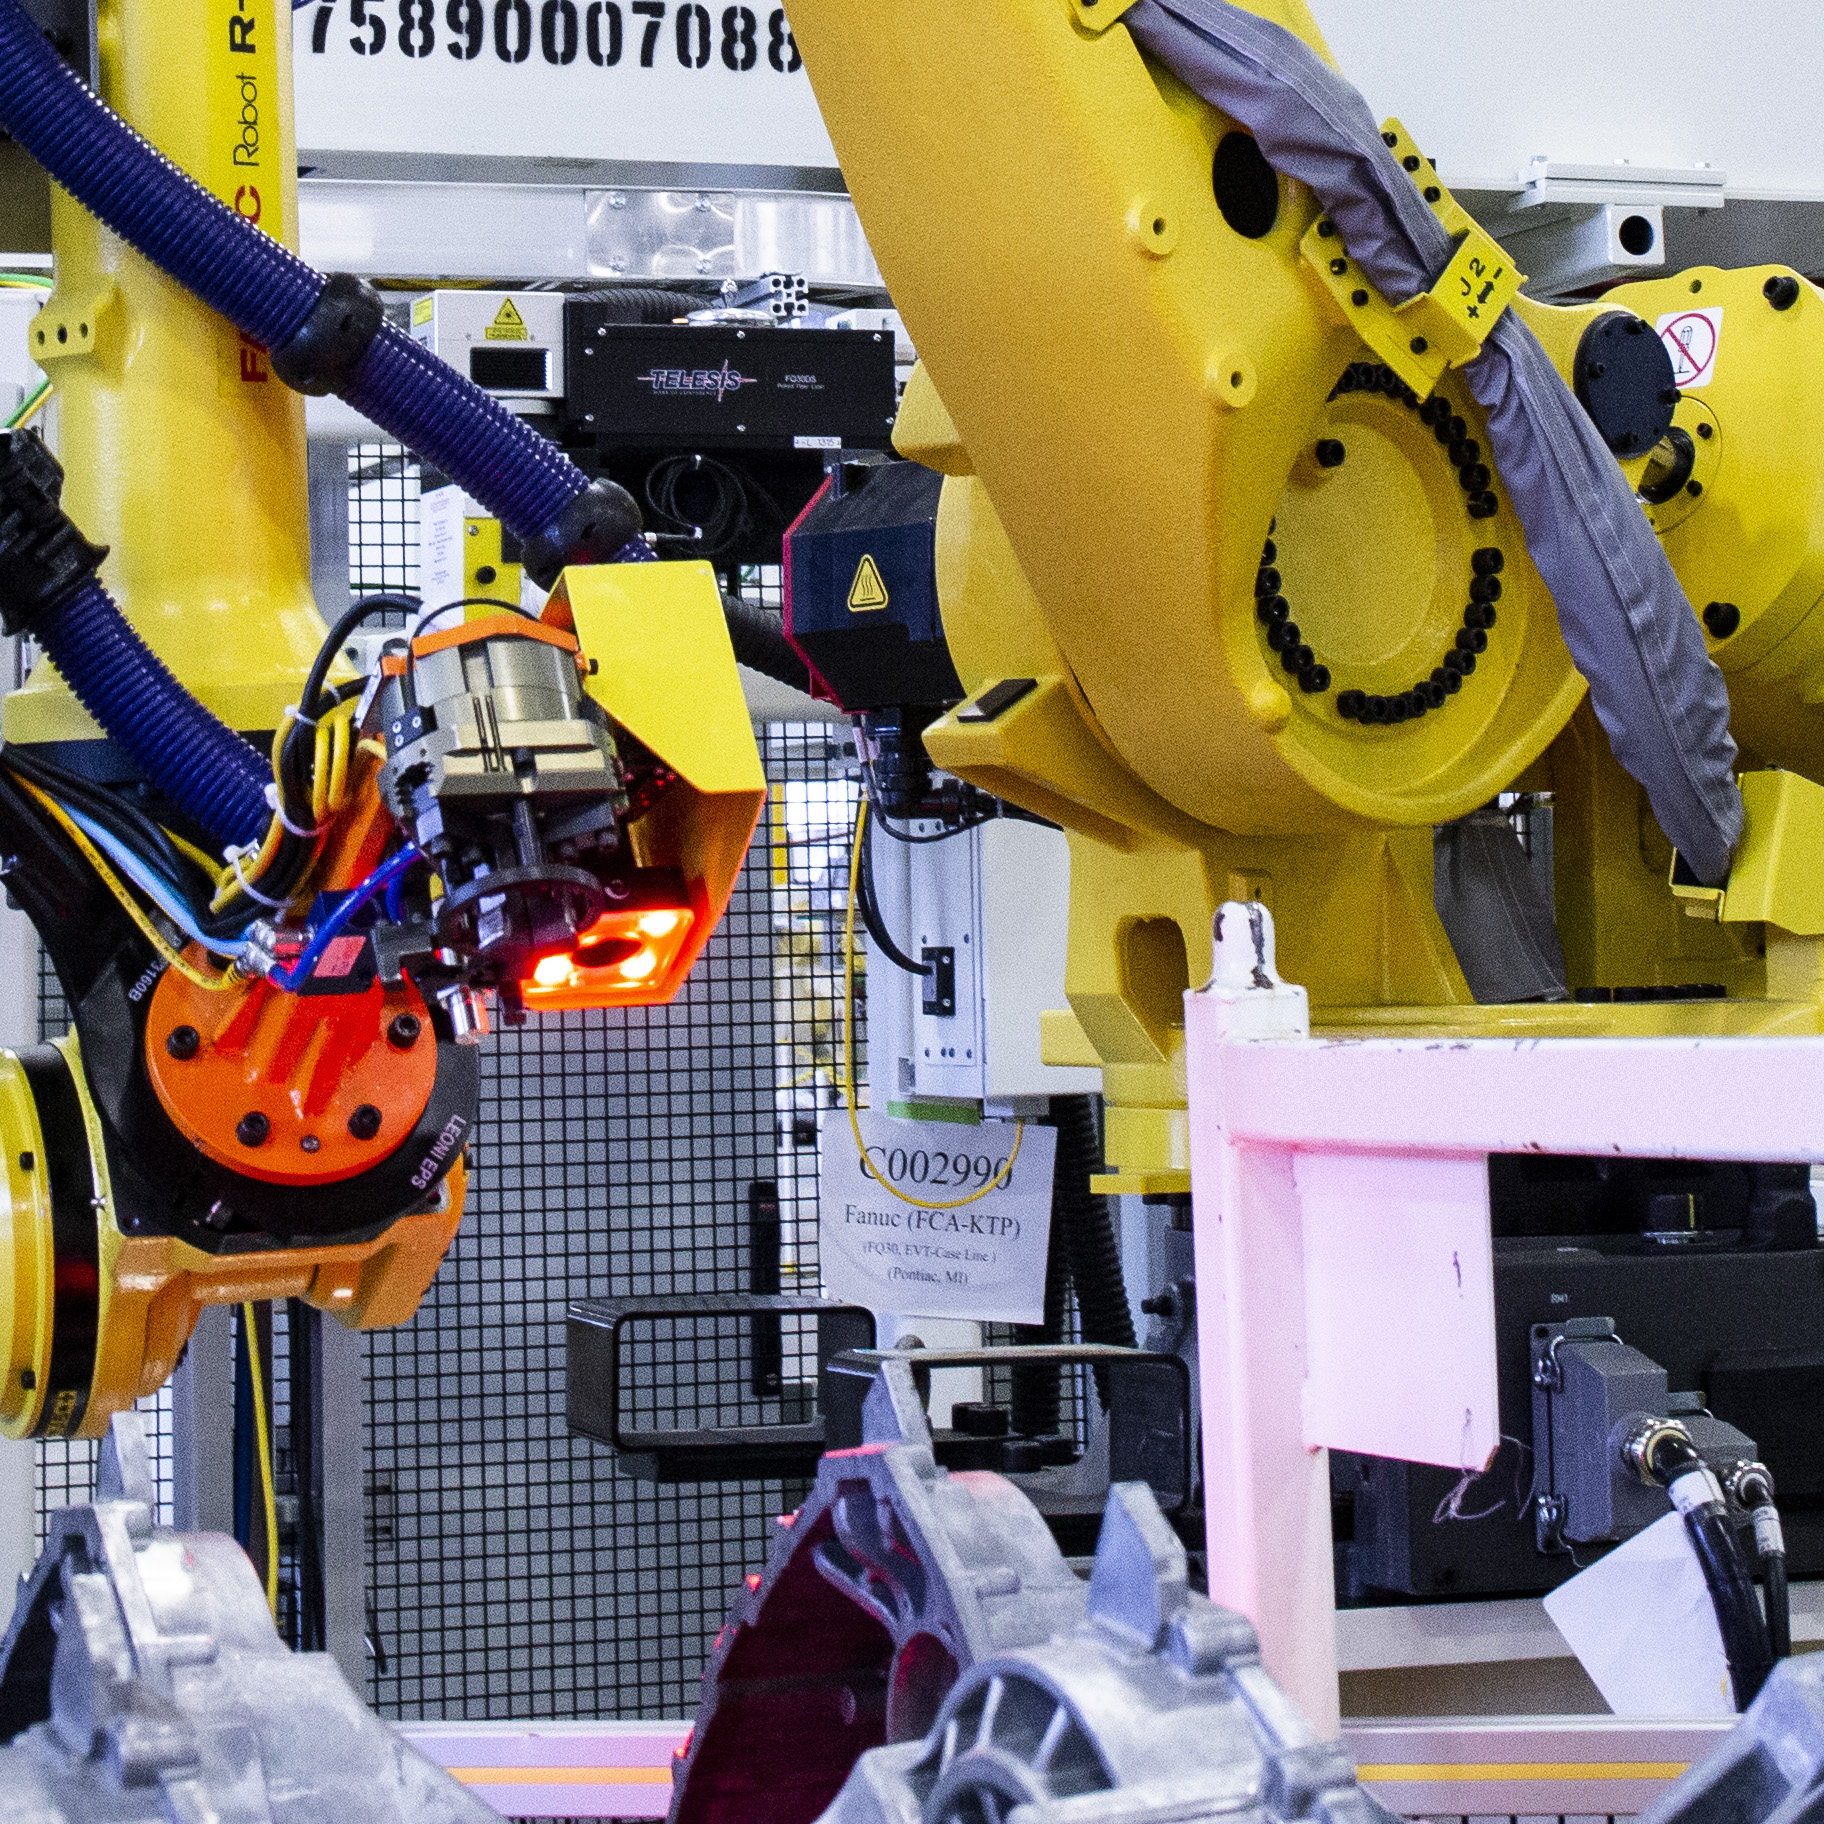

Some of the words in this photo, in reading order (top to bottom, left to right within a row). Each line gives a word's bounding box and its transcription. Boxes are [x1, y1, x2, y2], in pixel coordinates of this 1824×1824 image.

[233, 72, 260, 167] Robot
[649, 368, 743, 391] TELESIS
[429, 1114, 467, 1161] LEONI
[411, 1157, 439, 1190] EPS
[845, 1203, 901, 1227] Fanuc
[907, 1209, 1021, 1240] (FCA-KTP)
[887, 1266, 941, 1284] (Pontiac,
[945, 1270, 969, 1286] MI)
